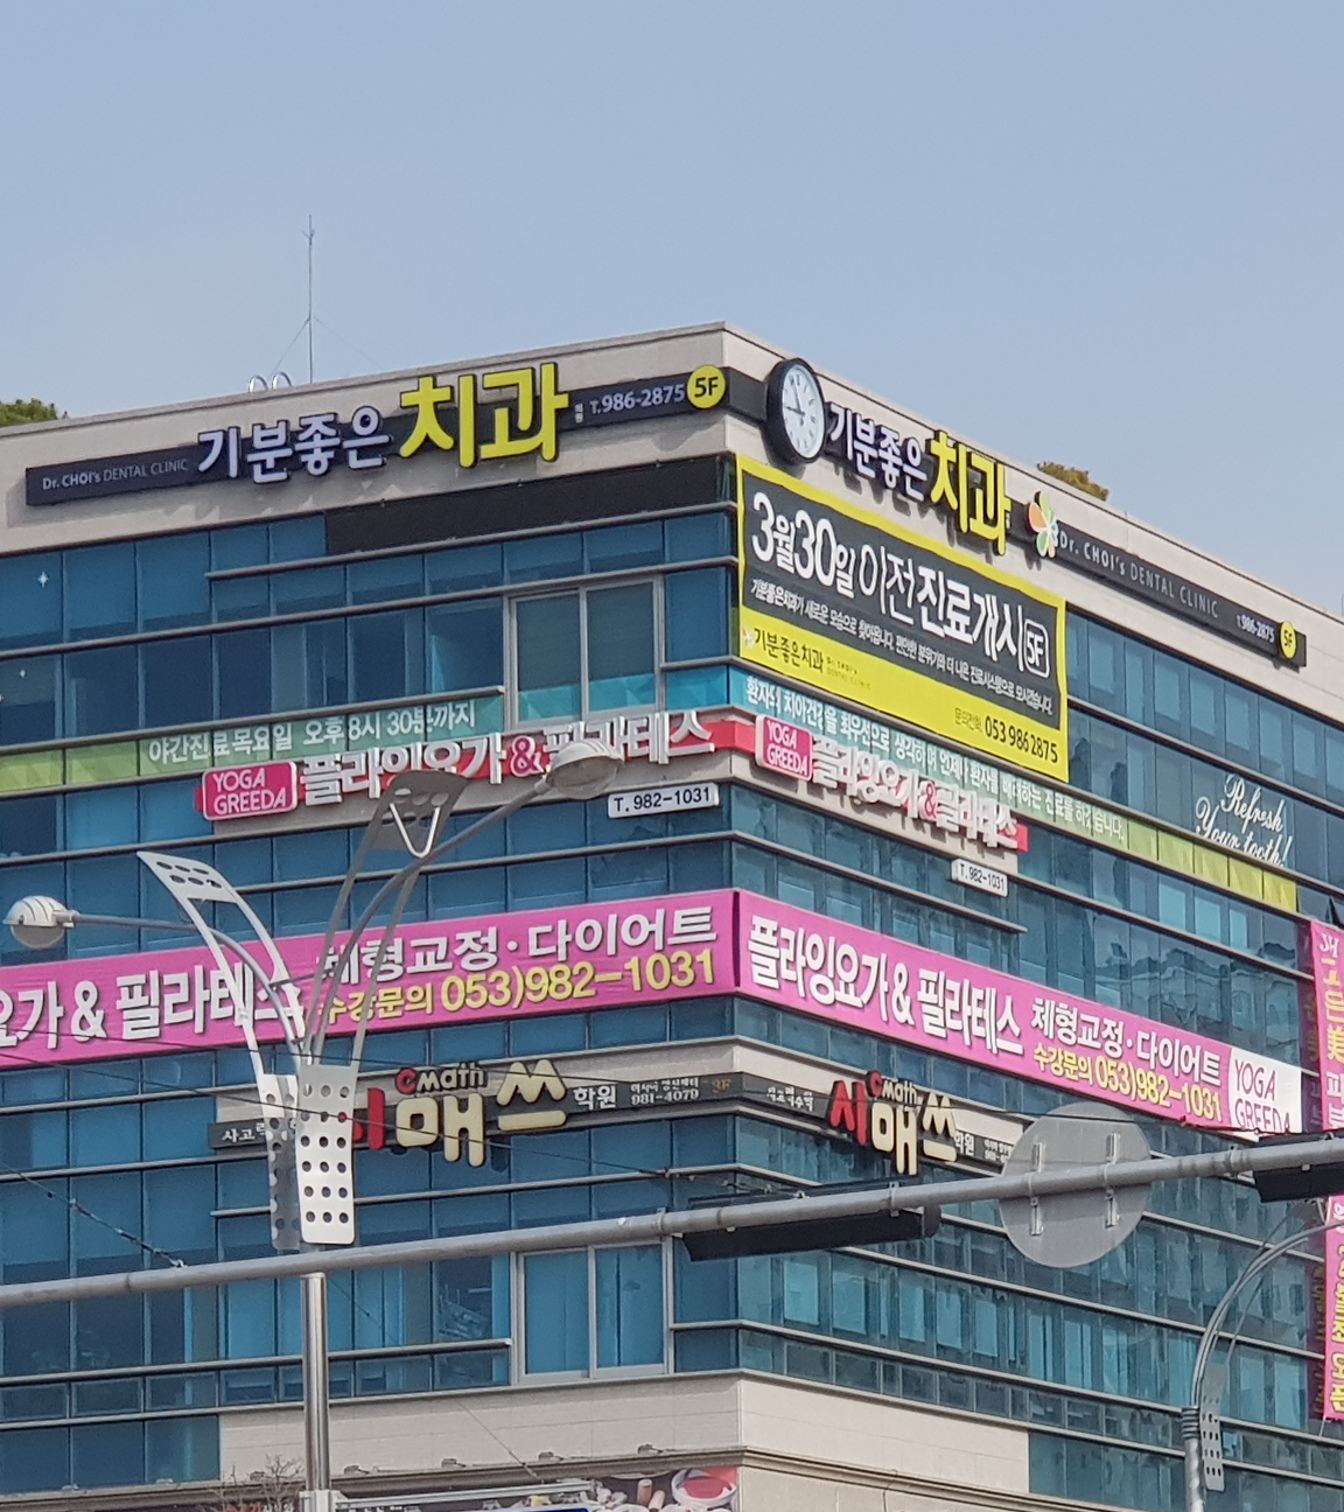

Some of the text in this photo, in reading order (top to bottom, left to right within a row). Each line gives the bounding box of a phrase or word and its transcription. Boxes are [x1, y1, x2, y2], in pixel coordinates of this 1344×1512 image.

[694, 376, 719, 399] 5F
[198, 362, 569, 484] 기분좋은 치과
[42, 457, 188, 491] Dr. CHOI's DENTAL CLINIC
[829, 401, 1009, 555] 기분좋은 치과
[1060, 532, 1219, 618] Dr. CHOI's DENTAL CLINIC
[1025, 630, 1045, 666] 5F
[1283, 629, 1293, 648] 5F
[766, 719, 798, 750] YOGA
[1031, 733, 1058, 764] 2875
[510, 743, 543, 777] &
[766, 745, 809, 778] GREEDA
[212, 770, 266, 793] YOGA
[214, 790, 288, 817] GREEDA
[920, 780, 939, 820] &
[1220, 774, 1284, 834] Refresh
[441, 950, 715, 1013] 053)982-1031
[748, 914, 1024, 1056] 플라잉요가 & 필라테스
[74, 980, 108, 1043] &
[574, 1085, 617, 1109] 학원
[1033, 1045, 1224, 1123] 수강문의 053)982-1031
[1234, 1058, 1277, 1101] YOGA
